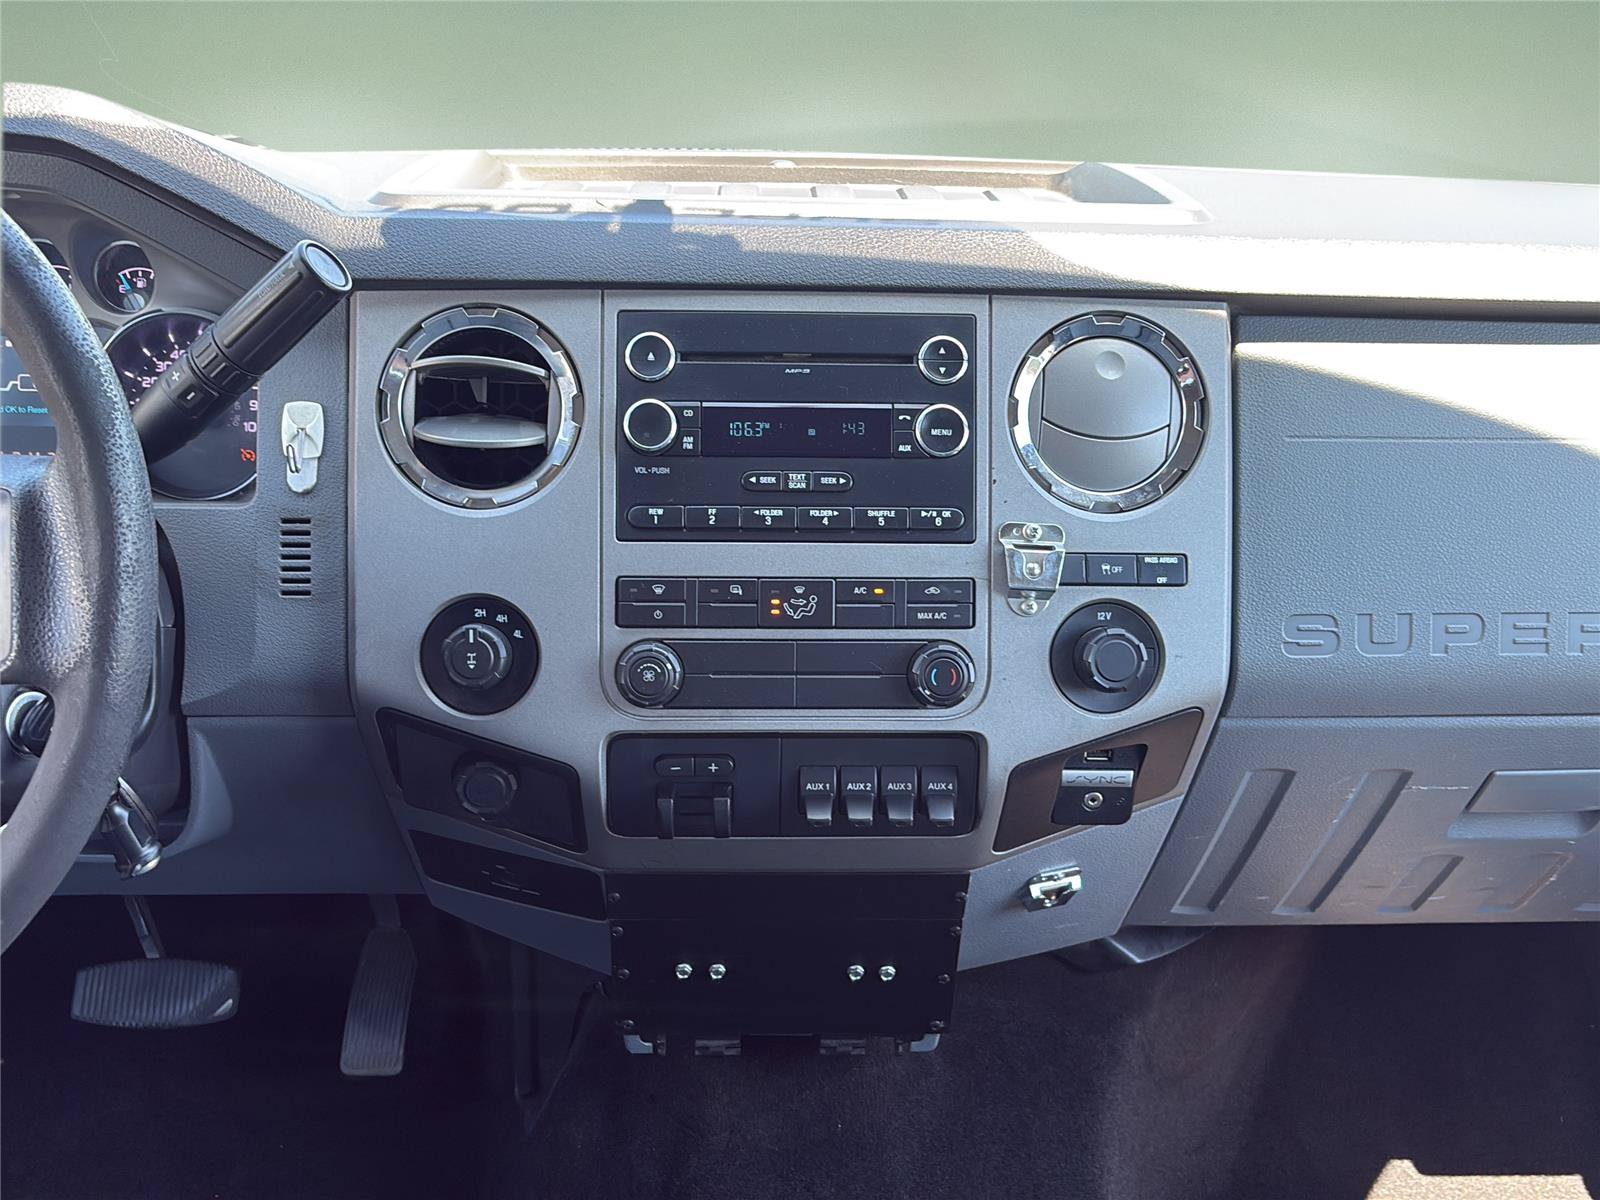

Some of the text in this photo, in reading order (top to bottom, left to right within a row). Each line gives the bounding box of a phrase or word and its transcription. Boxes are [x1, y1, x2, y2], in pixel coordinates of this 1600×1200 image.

[249, 400, 258, 411] 9
[243, 422, 257, 433] 10
[931, 428, 952, 436] MENU
[788, 473, 806, 481] TEXT
[653, 516, 658, 525] 1
[709, 516, 716, 525] 2
[765, 517, 772, 525] 3
[822, 517, 829, 526] 4
[878, 518, 885, 526] 5
[935, 518, 942, 526] 6
[1111, 566, 1123, 574] OFF
[474, 608, 486, 617] 2H
[495, 614, 508, 623] 4H
[1066, 775, 1127, 785] SYNC
